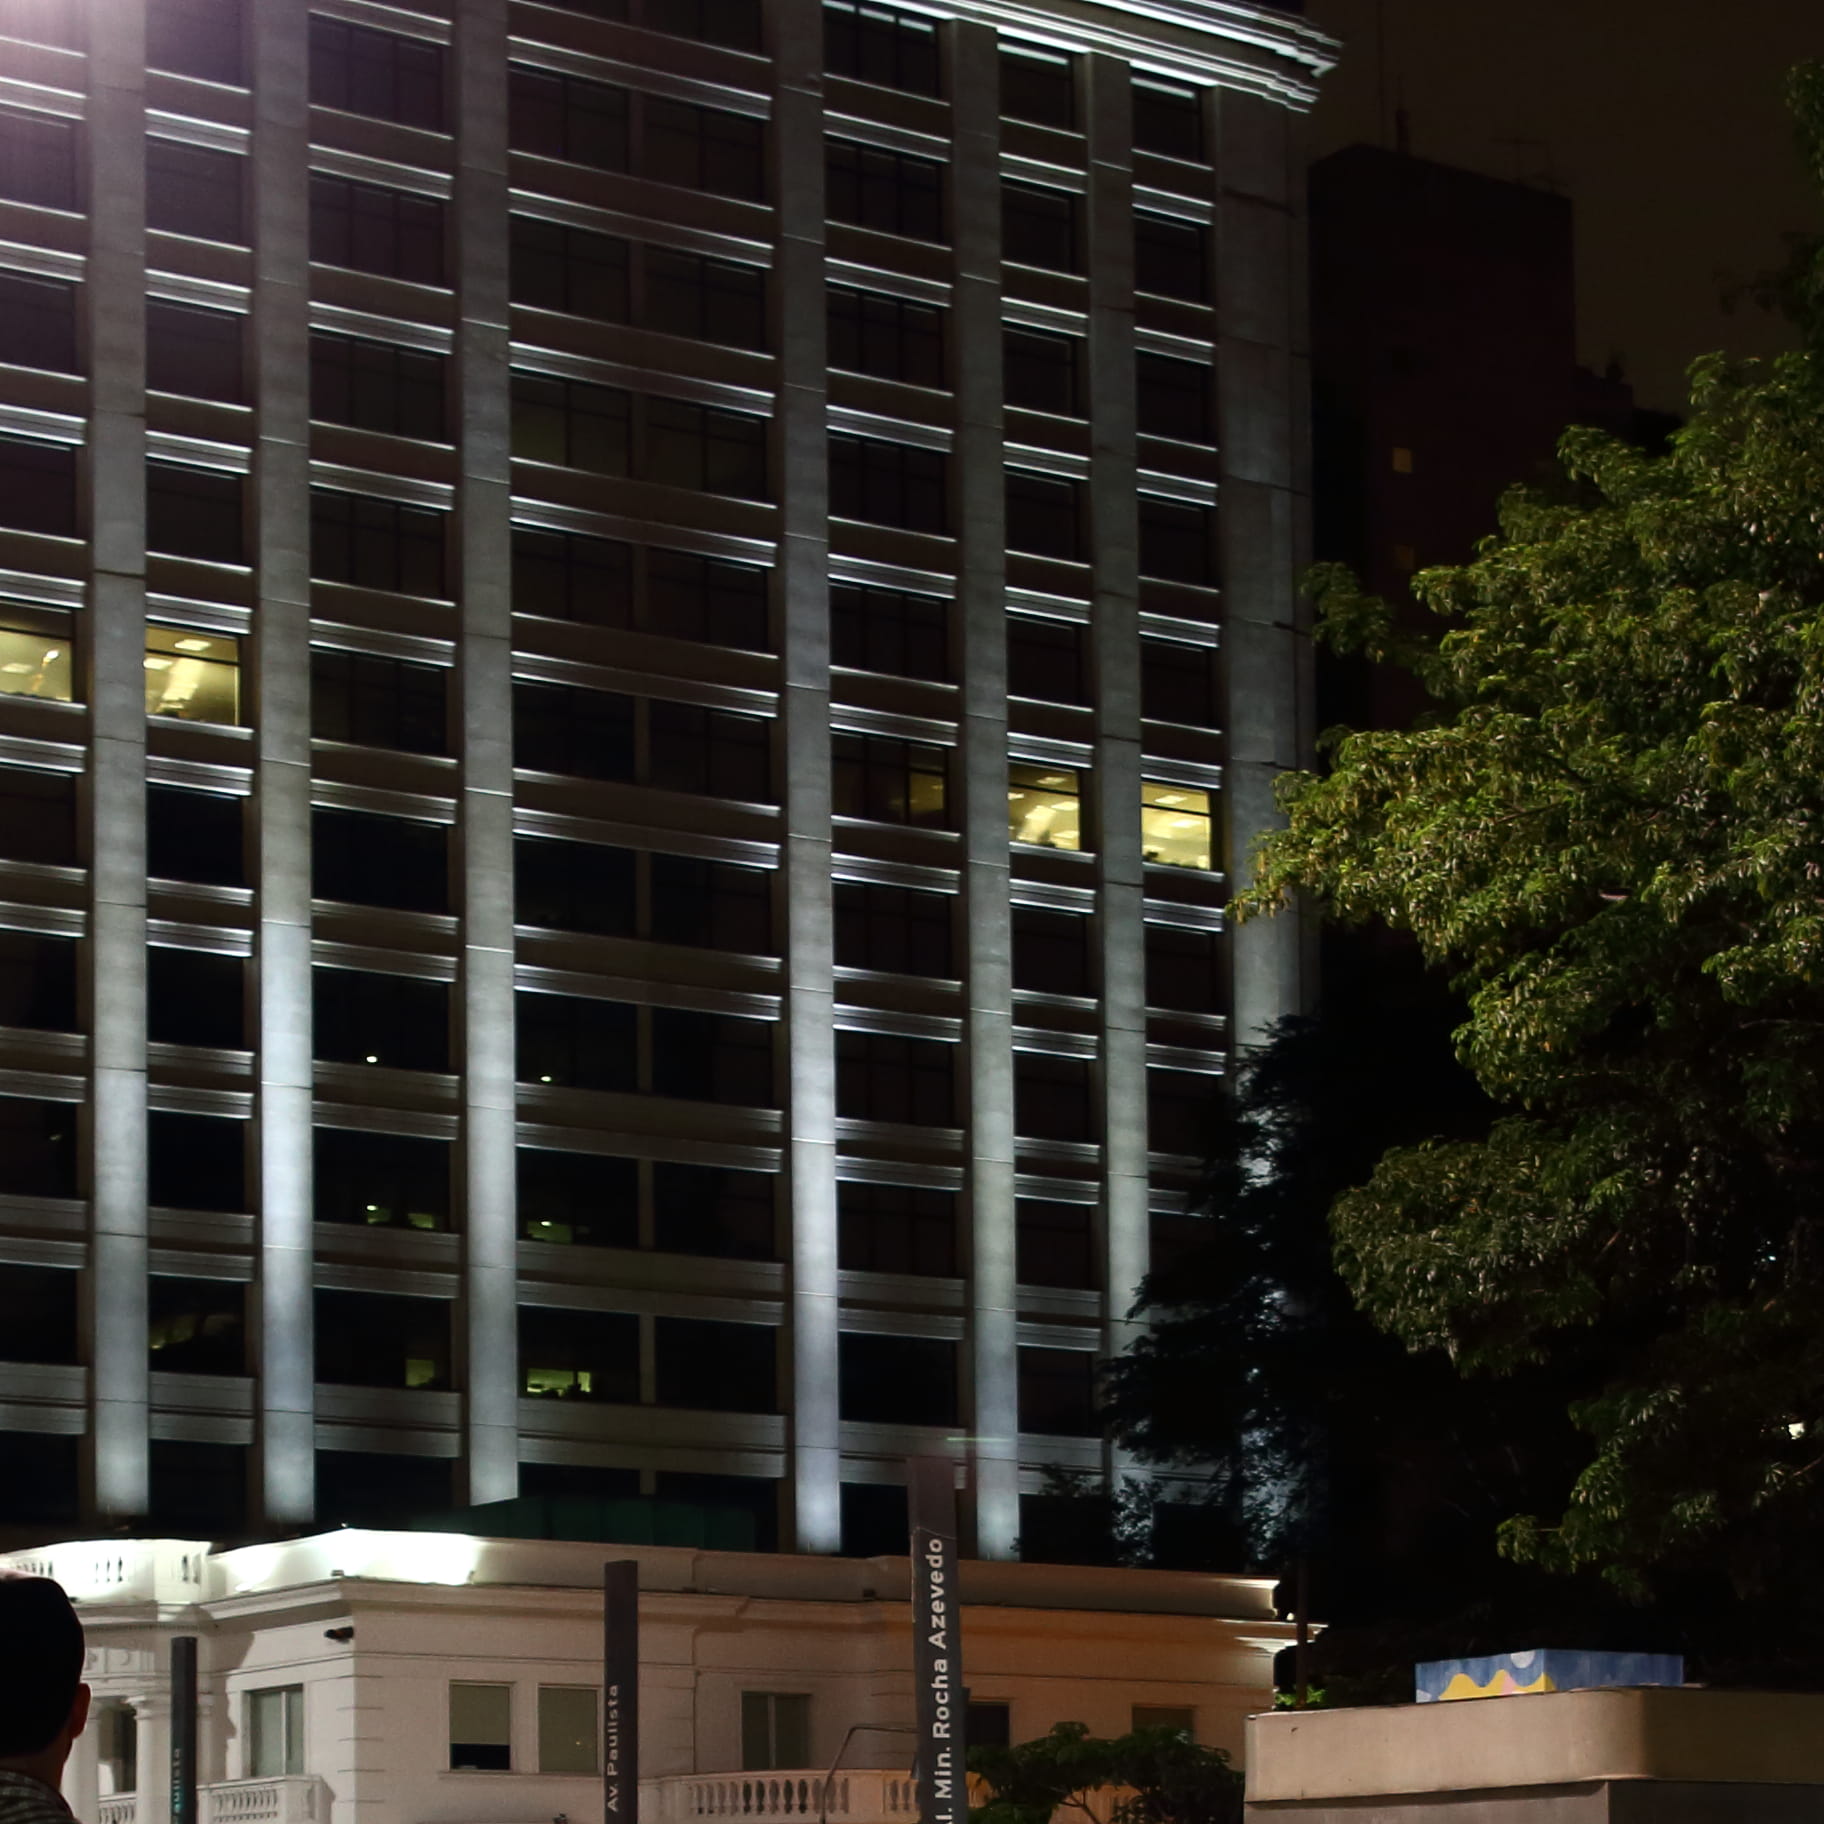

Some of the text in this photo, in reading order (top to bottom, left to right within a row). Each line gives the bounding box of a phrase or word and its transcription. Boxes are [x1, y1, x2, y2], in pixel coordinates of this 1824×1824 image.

[926, 1538, 947, 1650] Azevedo
[931, 1658, 951, 1739] Rocha
[606, 1684, 619, 1813] Av. Paulista
[933, 1747, 953, 1800] Min.
